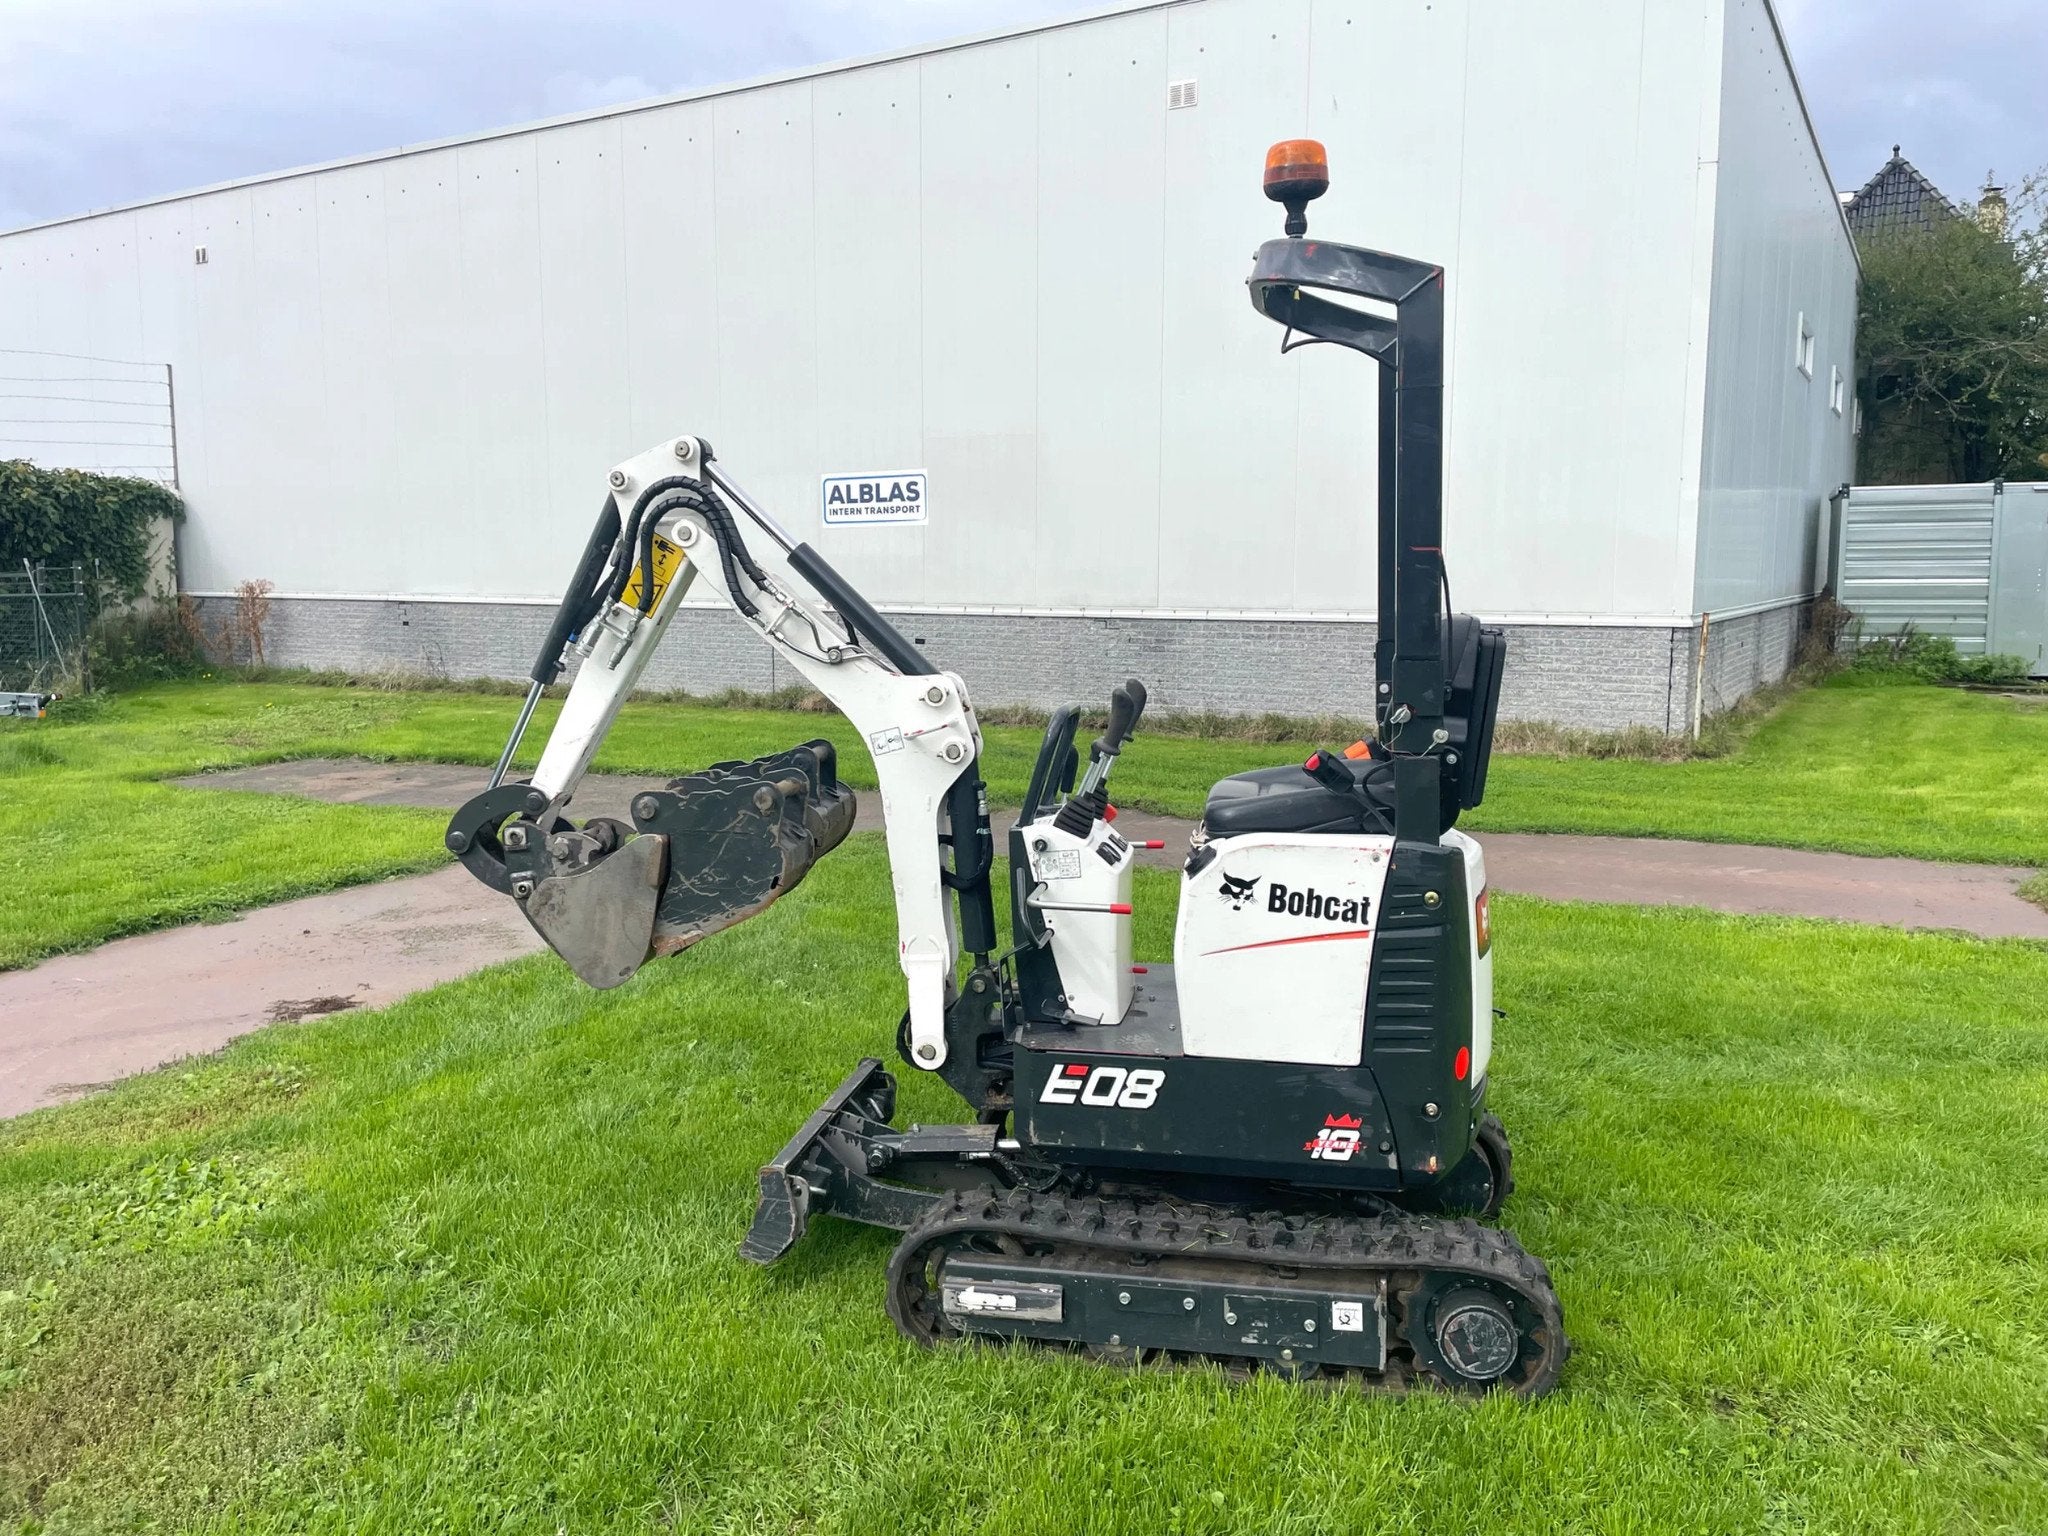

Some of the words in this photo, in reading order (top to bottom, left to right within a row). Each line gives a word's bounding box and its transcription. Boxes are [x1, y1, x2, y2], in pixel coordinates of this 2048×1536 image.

[828, 481, 920, 505] ALBLAS
[829, 507, 862, 516] INTERN
[865, 505, 921, 515] TRANSPORT
[1268, 883, 1371, 925] Bobcat
[1039, 1064, 1166, 1109] E08
[1318, 1140, 1356, 1149] YEARS
